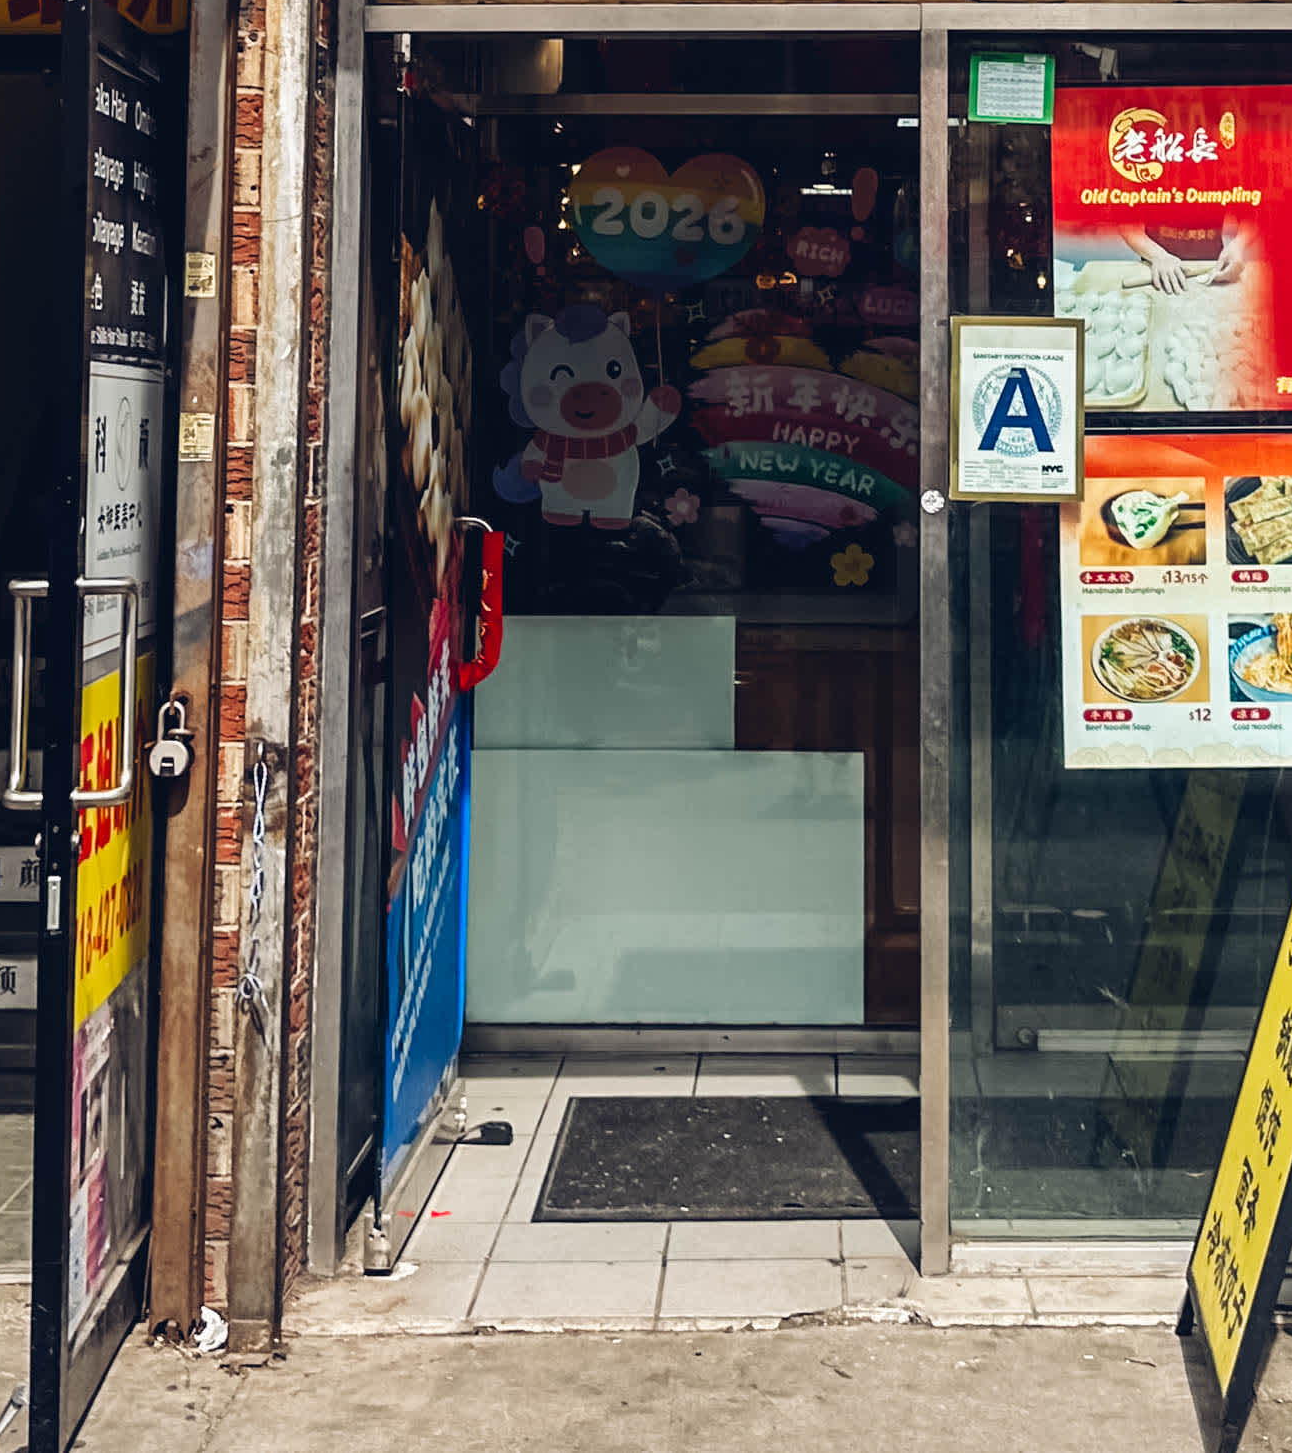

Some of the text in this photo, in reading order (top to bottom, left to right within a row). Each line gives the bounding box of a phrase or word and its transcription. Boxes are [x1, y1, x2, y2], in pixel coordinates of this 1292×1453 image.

[1081, 187, 1262, 207] Old Captain's Dumpling
[593, 188, 746, 246] 2026
[795, 240, 845, 264] RICH
[977, 367, 1055, 452] A
[772, 420, 860, 455] HAPPY
[739, 450, 876, 496] NEW YEAR
[1188, 707, 1212, 722] $12
